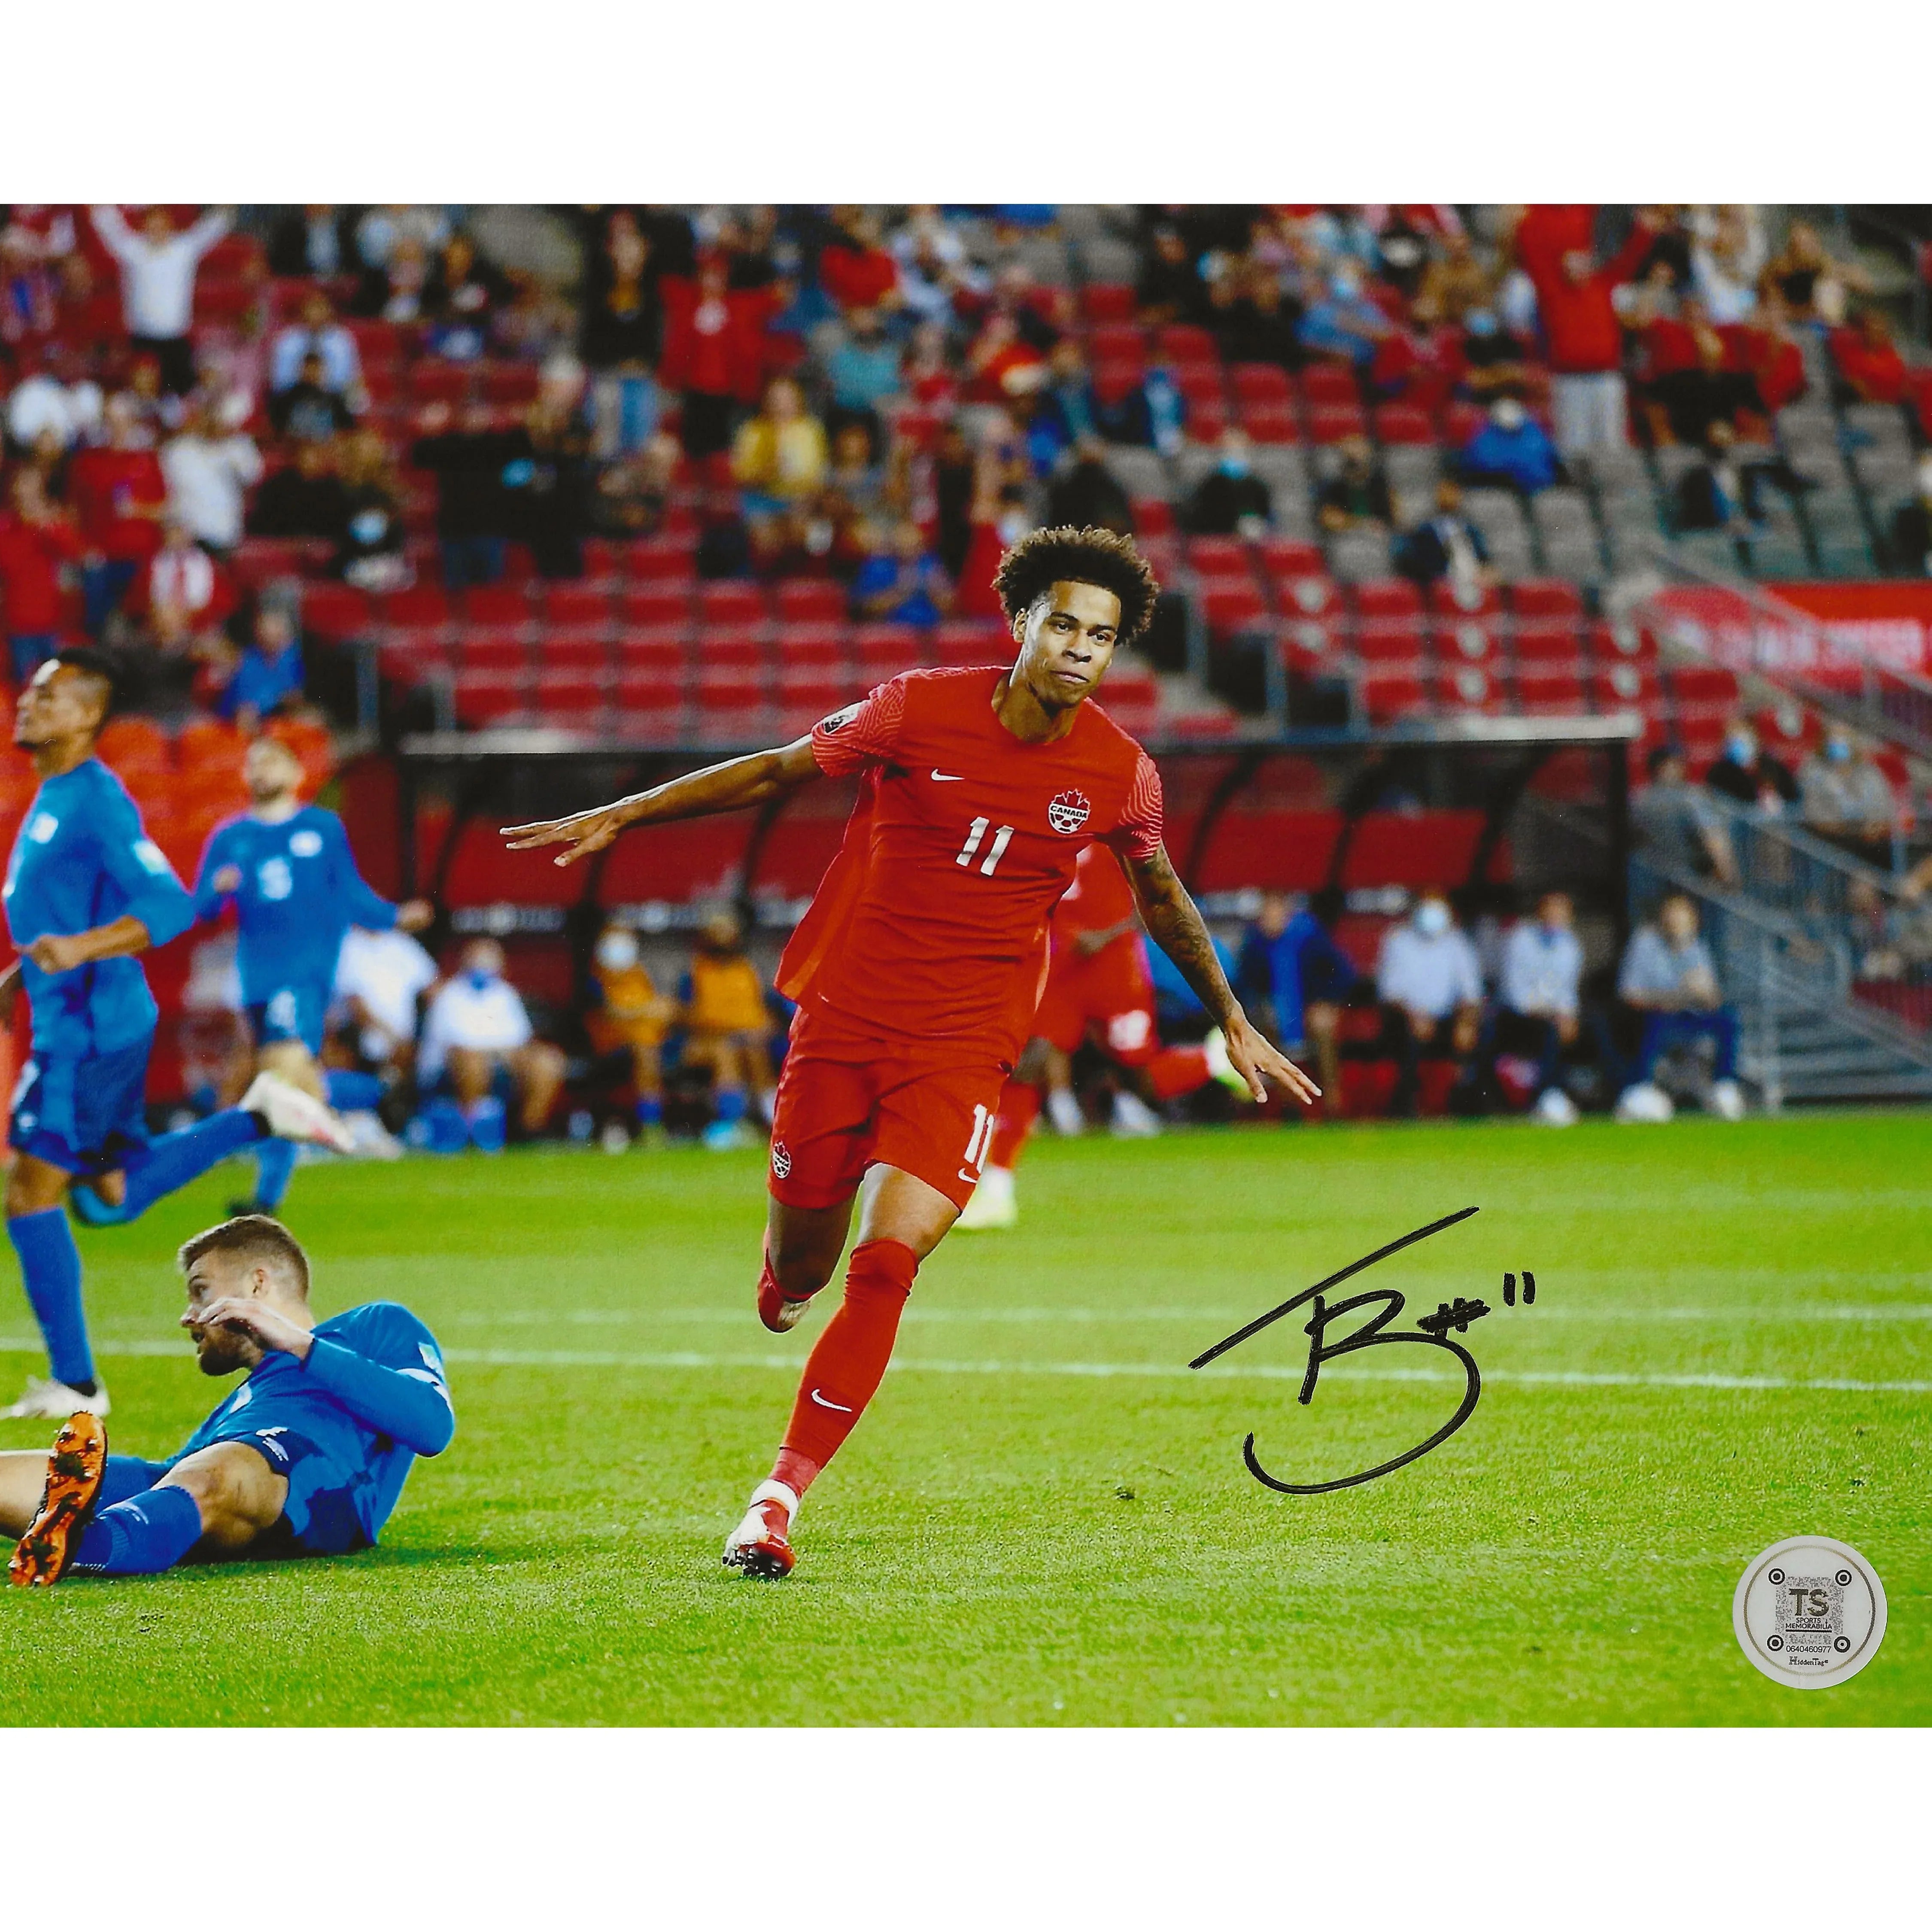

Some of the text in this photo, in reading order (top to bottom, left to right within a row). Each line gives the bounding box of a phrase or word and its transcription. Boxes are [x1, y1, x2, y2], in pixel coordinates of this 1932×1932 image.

[1050, 805, 1087, 818] CANADA
[956, 816, 1014, 876] 11
[964, 1103, 995, 1174] 11
[1788, 1588, 1829, 1617] TS
